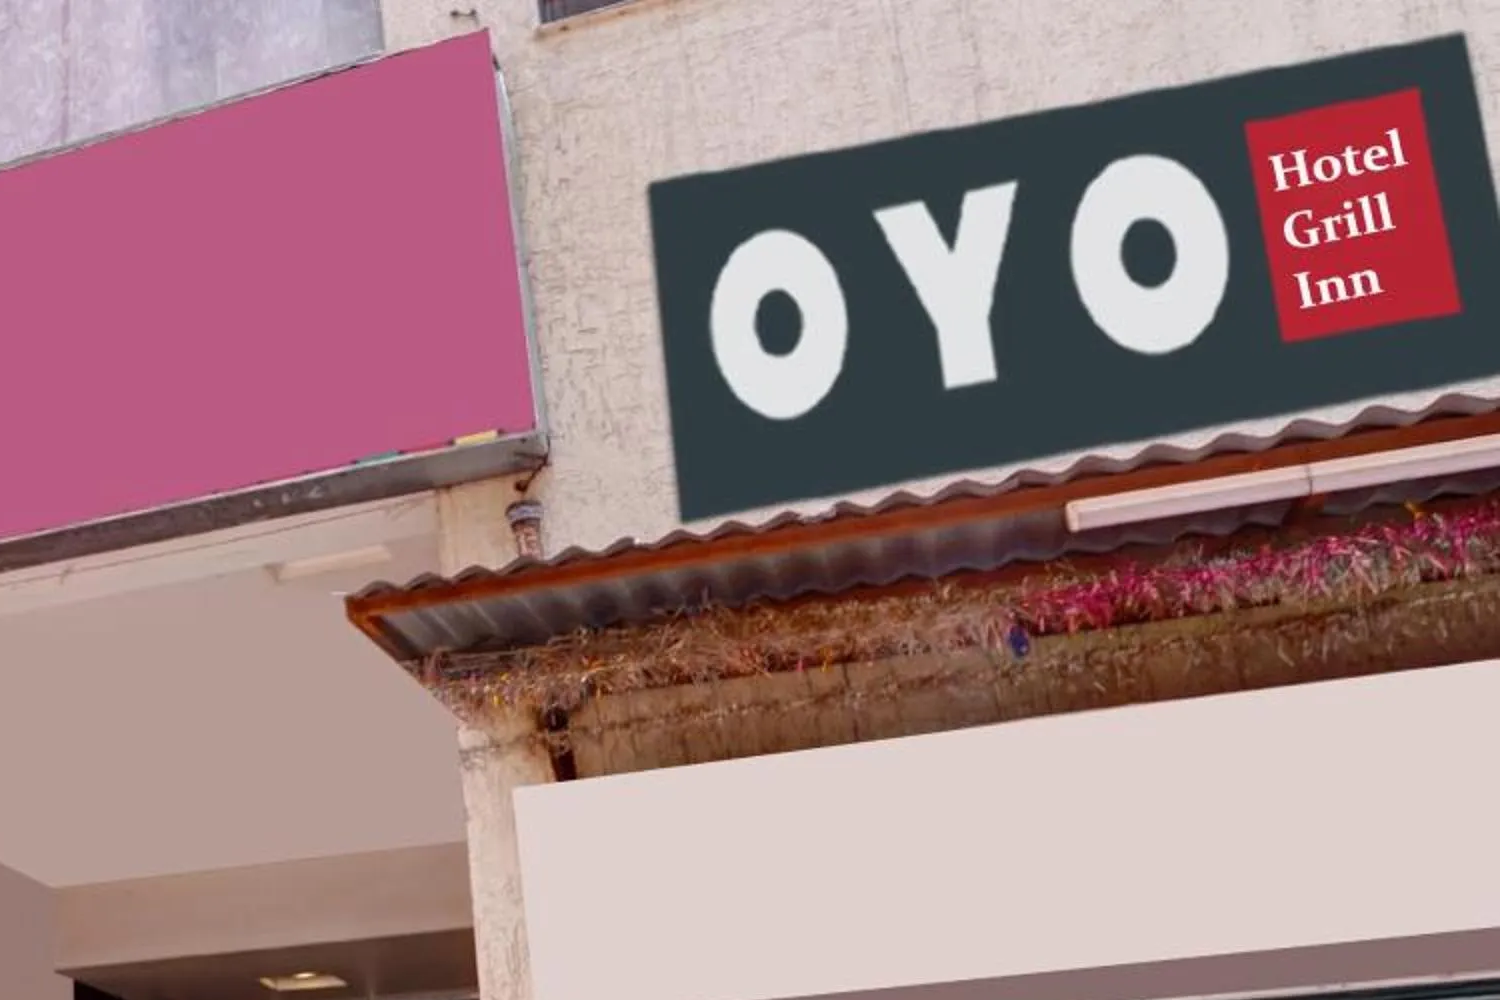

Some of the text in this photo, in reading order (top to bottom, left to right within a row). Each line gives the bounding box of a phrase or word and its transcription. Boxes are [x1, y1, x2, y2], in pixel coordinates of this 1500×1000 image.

[1268, 127, 1409, 192] Hotel
[1283, 191, 1397, 249] Grill
[710, 155, 1229, 419] OYO
[1293, 267, 1385, 310] Inn
